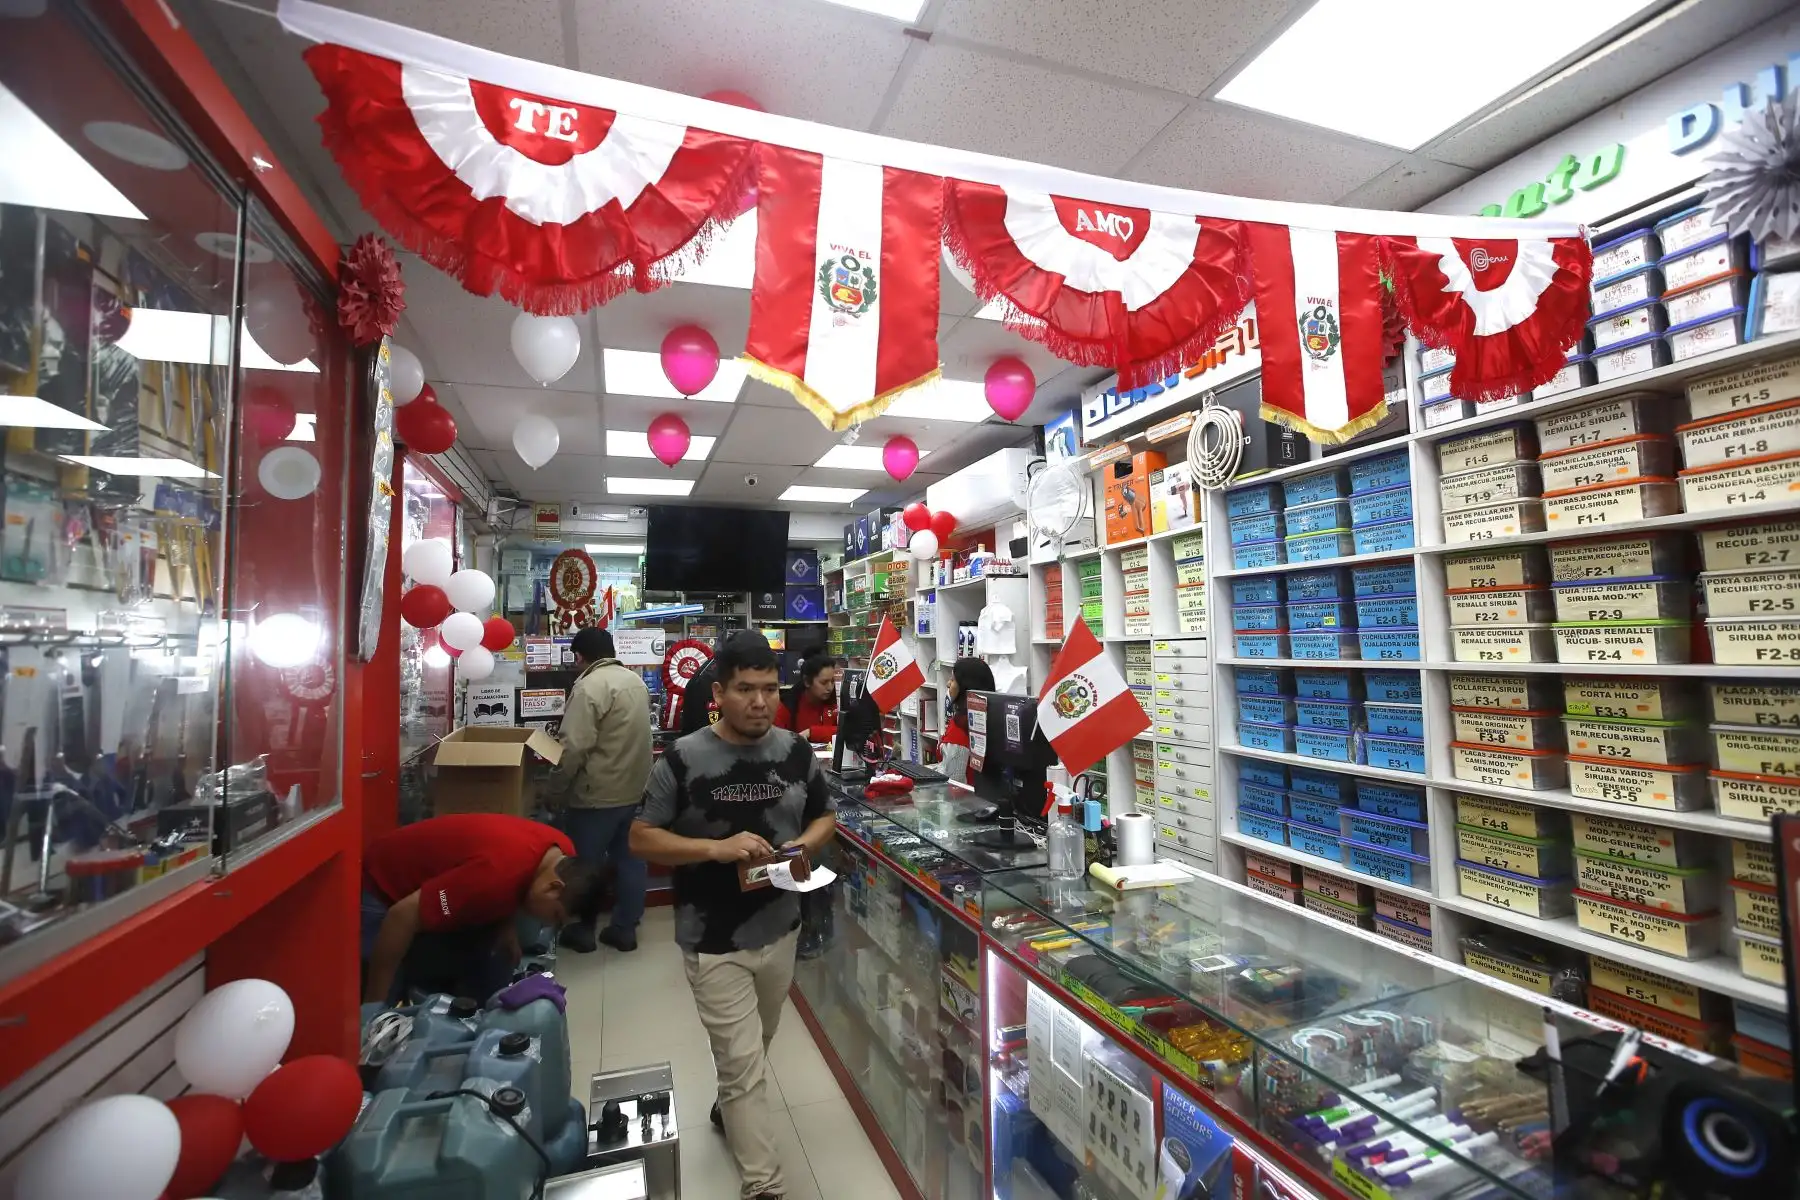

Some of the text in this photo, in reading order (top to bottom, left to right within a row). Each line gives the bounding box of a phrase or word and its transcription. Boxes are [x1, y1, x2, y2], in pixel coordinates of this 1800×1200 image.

[510, 98, 578, 141] TE
[830, 243, 871, 259] VIVA EL
[1307, 297, 1325, 305] VIVA
[1731, 389, 1770, 407] F1-5
[1548, 404, 1621, 426] BARRA DE PATA
[1545, 412, 1627, 436] REMALLE SIRUBA
[1686, 416, 1764, 438] PROTECTOR DE
[1570, 430, 1601, 445] F1-7
[1692, 432, 1729, 445] PALLAR
[1725, 440, 1768, 458] F1-8
[1465, 455, 1488, 466] F1-6
[1476, 468, 1513, 479] TELA BASTA
[1686, 469, 1752, 484] PRENSATELA
[1575, 474, 1604, 486] F1-2
[1465, 492, 1491, 503] F1-9
[1615, 488, 1636, 496] REM.
[1727, 490, 1766, 504] F1-4
[1371, 509, 1391, 519] E1-8
[1447, 513, 1462, 521] BASE
[1578, 513, 1605, 524] F1-1
[1470, 531, 1493, 541] F1-3
[1727, 528, 1758, 537] GUIA
[1374, 544, 1393, 552] E1-7
[1745, 550, 1790, 564] F2-7
[1586, 566, 1615, 576] F2-1
[566, 573, 580, 586] 28
[1471, 578, 1496, 587] F2-6
[1744, 575, 1785, 583] GARFIO
[1373, 585, 1393, 593] E2-9
[1607, 583, 1652, 591] REMALLE
[1749, 598, 1794, 611] F2-5
[1376, 616, 1397, 624] E2-6
[1476, 613, 1499, 621] F2-2
[1589, 610, 1622, 620] F2-9
[1381, 650, 1402, 658] E2-5
[1480, 652, 1503, 660] F2-3
[1588, 650, 1621, 660] F2-4
[1756, 648, 1800, 660] F2-8
[1386, 690, 1409, 699] E3-9
[1476, 697, 1500, 706] F3-1
[1595, 706, 1628, 718] F3-3
[1312, 717, 1331, 725] E3-3
[1755, 713, 1800, 726] F3-4
[1387, 726, 1408, 734] E3-4
[1580, 723, 1645, 733] PRETENSORES
[1252, 738, 1268, 746] E3-6
[1480, 733, 1505, 743] F3-8
[1312, 748, 1329, 756] E3-7
[1488, 752, 1523, 761] JEANERO
[1598, 745, 1631, 758] F3-2
[1388, 759, 1409, 769] E3-1
[1474, 766, 1510, 775] GENERICO
[1585, 765, 1653, 778] PLACAS VARIOS
[1482, 776, 1503, 784] F3-7
[1585, 773, 1615, 782] SIRUBA
[711, 783, 784, 802] TAZMANIA
[1597, 782, 1641, 792] GENERICO
[1722, 781, 1764, 793] PORTA
[1603, 788, 1637, 801] F3-5
[1729, 793, 1777, 805] SIRUBA
[1306, 815, 1323, 824] E4-5
[1482, 818, 1508, 830] F4-8
[1585, 817, 1656, 835] PORTA AGUJAS
[1252, 827, 1268, 838] E4-3
[1370, 835, 1389, 846] E4-7
[1476, 835, 1502, 846] REMALLE
[1504, 842, 1534, 852] PEGASUS
[1305, 843, 1324, 854] E4-6
[1461, 839, 1521, 856] ORIGINAL GENERICO
[1608, 848, 1636, 860] F4-1
[1485, 857, 1508, 868] F4-7
[1586, 859, 1624, 872] PLACAS
[1581, 872, 1600, 882] JACK
[1586, 866, 1622, 881] SIRUBA
[1479, 871, 1505, 884] REMALLE
[1507, 881, 1536, 892] DELANTE
[1319, 885, 1340, 899] E5-9
[1601, 879, 1655, 897] GENERICO
[1486, 893, 1510, 907] F4-4
[1610, 888, 1646, 905] F3-6
[1578, 899, 1598, 908] PATA
[1396, 911, 1418, 925] E5-4
[1610, 923, 1645, 942] F4-9
[1626, 986, 1657, 1004] F5-1
[1165, 1088, 1195, 1116] LASER
